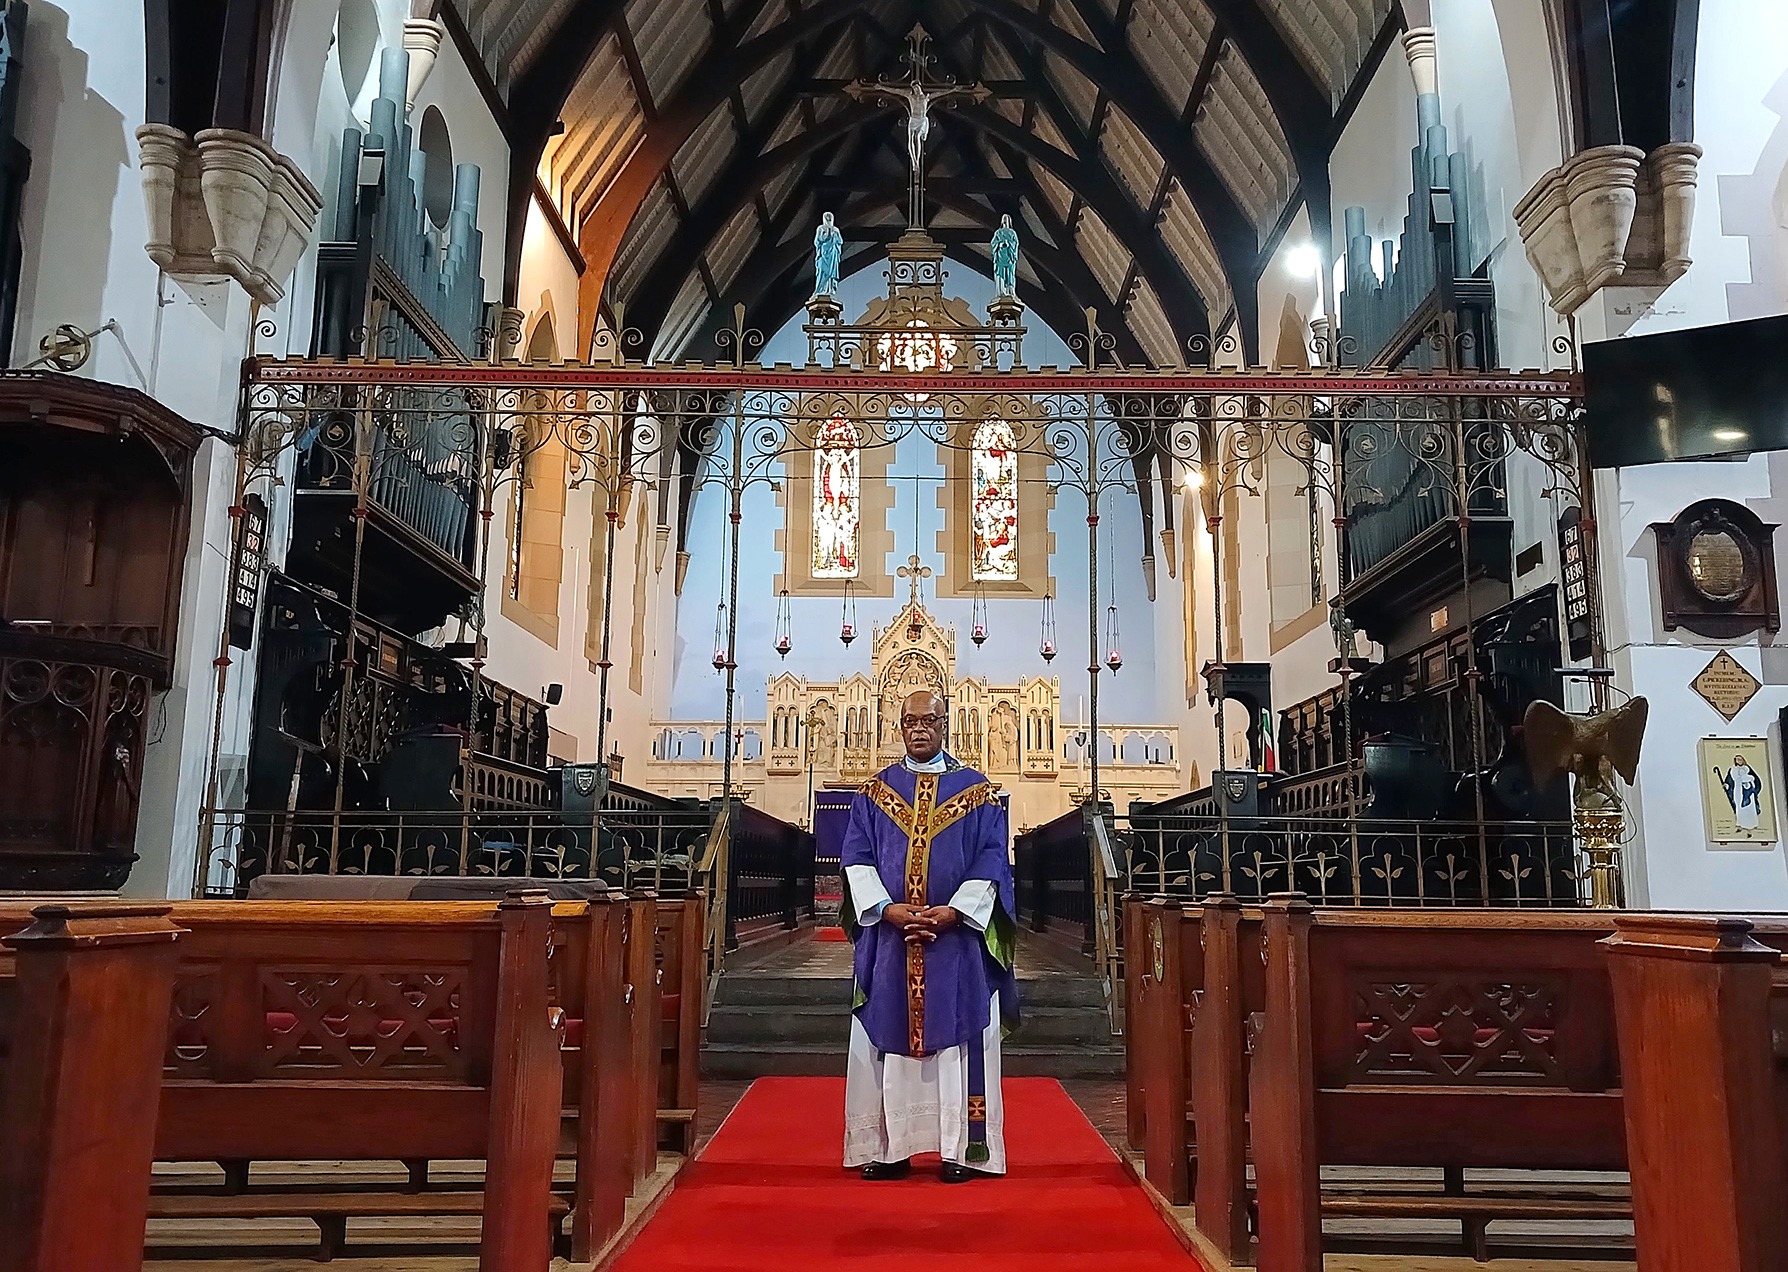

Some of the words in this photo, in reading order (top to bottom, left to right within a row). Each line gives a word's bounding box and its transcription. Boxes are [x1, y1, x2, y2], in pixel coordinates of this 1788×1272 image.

[249, 514, 262, 533] 67
[247, 533, 259, 551] 32
[1565, 526, 1578, 545] 67
[1566, 545, 1579, 563] 32
[239, 569, 257, 589] 414
[1566, 562, 1583, 582] 383
[237, 588, 254, 608] 495
[1567, 581, 1585, 600] 414
[1569, 600, 1587, 619] 495
